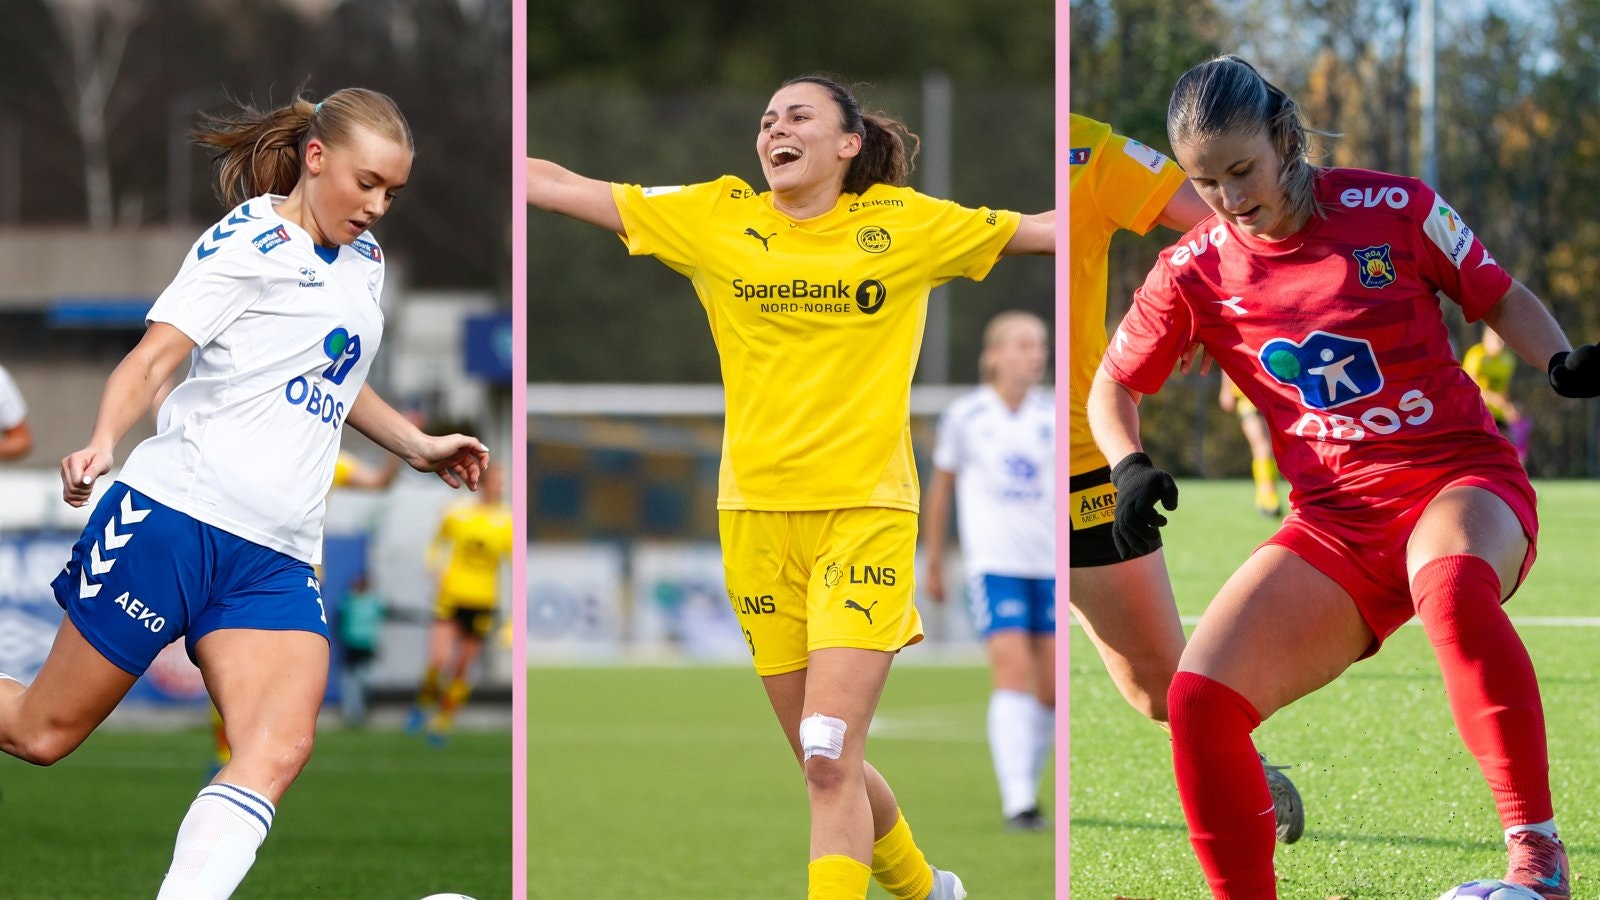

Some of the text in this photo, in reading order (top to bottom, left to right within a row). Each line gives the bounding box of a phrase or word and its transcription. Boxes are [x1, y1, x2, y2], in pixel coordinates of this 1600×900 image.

[862, 199, 904, 208] Elkem
[1340, 186, 1409, 210] evo
[1170, 223, 1228, 266] evo
[298, 280, 325, 288] hummel
[732, 278, 850, 302] SpareBank
[760, 303, 850, 313] NORD-NORGE
[285, 375, 344, 430] OBOS
[1295, 389, 1434, 442] OBOS
[849, 565, 896, 587] LNS
[114, 591, 166, 634] AEKO
[737, 594, 776, 615] LNS
